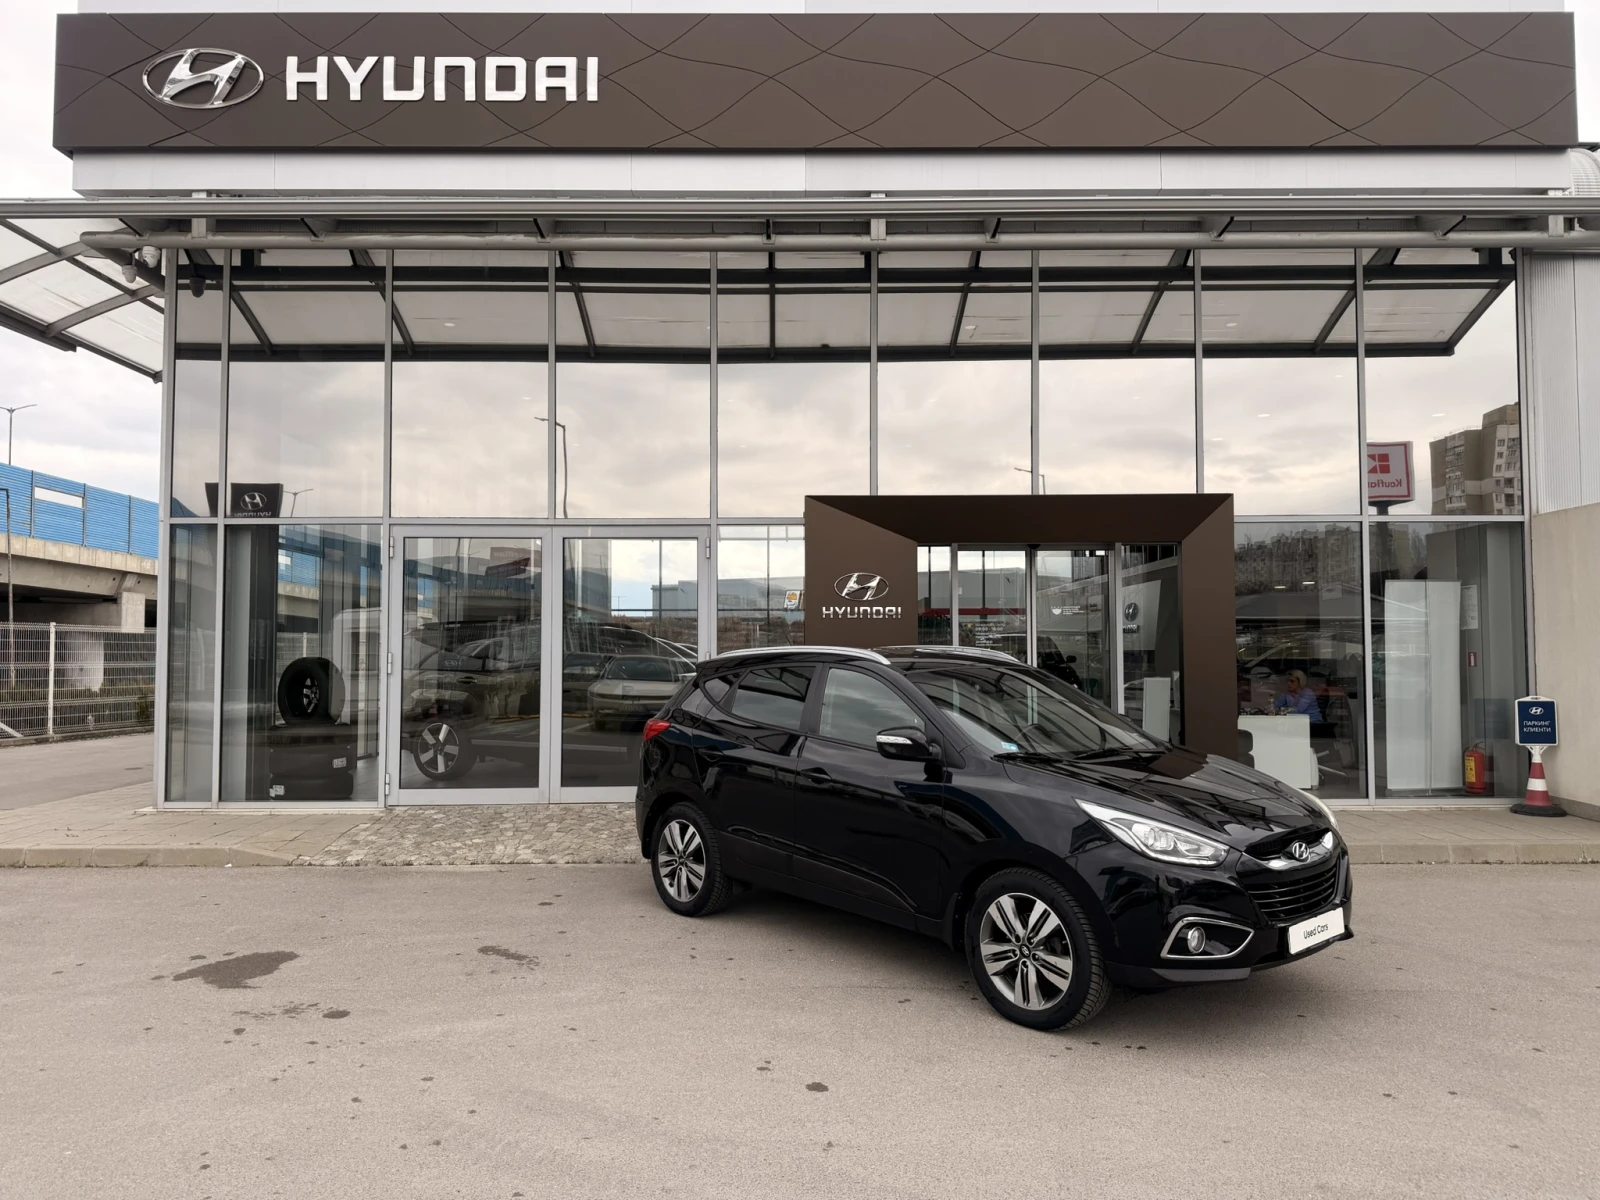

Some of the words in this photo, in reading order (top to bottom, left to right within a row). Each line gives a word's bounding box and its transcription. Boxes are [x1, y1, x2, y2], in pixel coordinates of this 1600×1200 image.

[286, 56, 599, 101] HYUNDAI
[822, 606, 902, 619] HYUNDAI
[1303, 926, 1316, 939] Used
[1317, 924, 1329, 934] Cars
